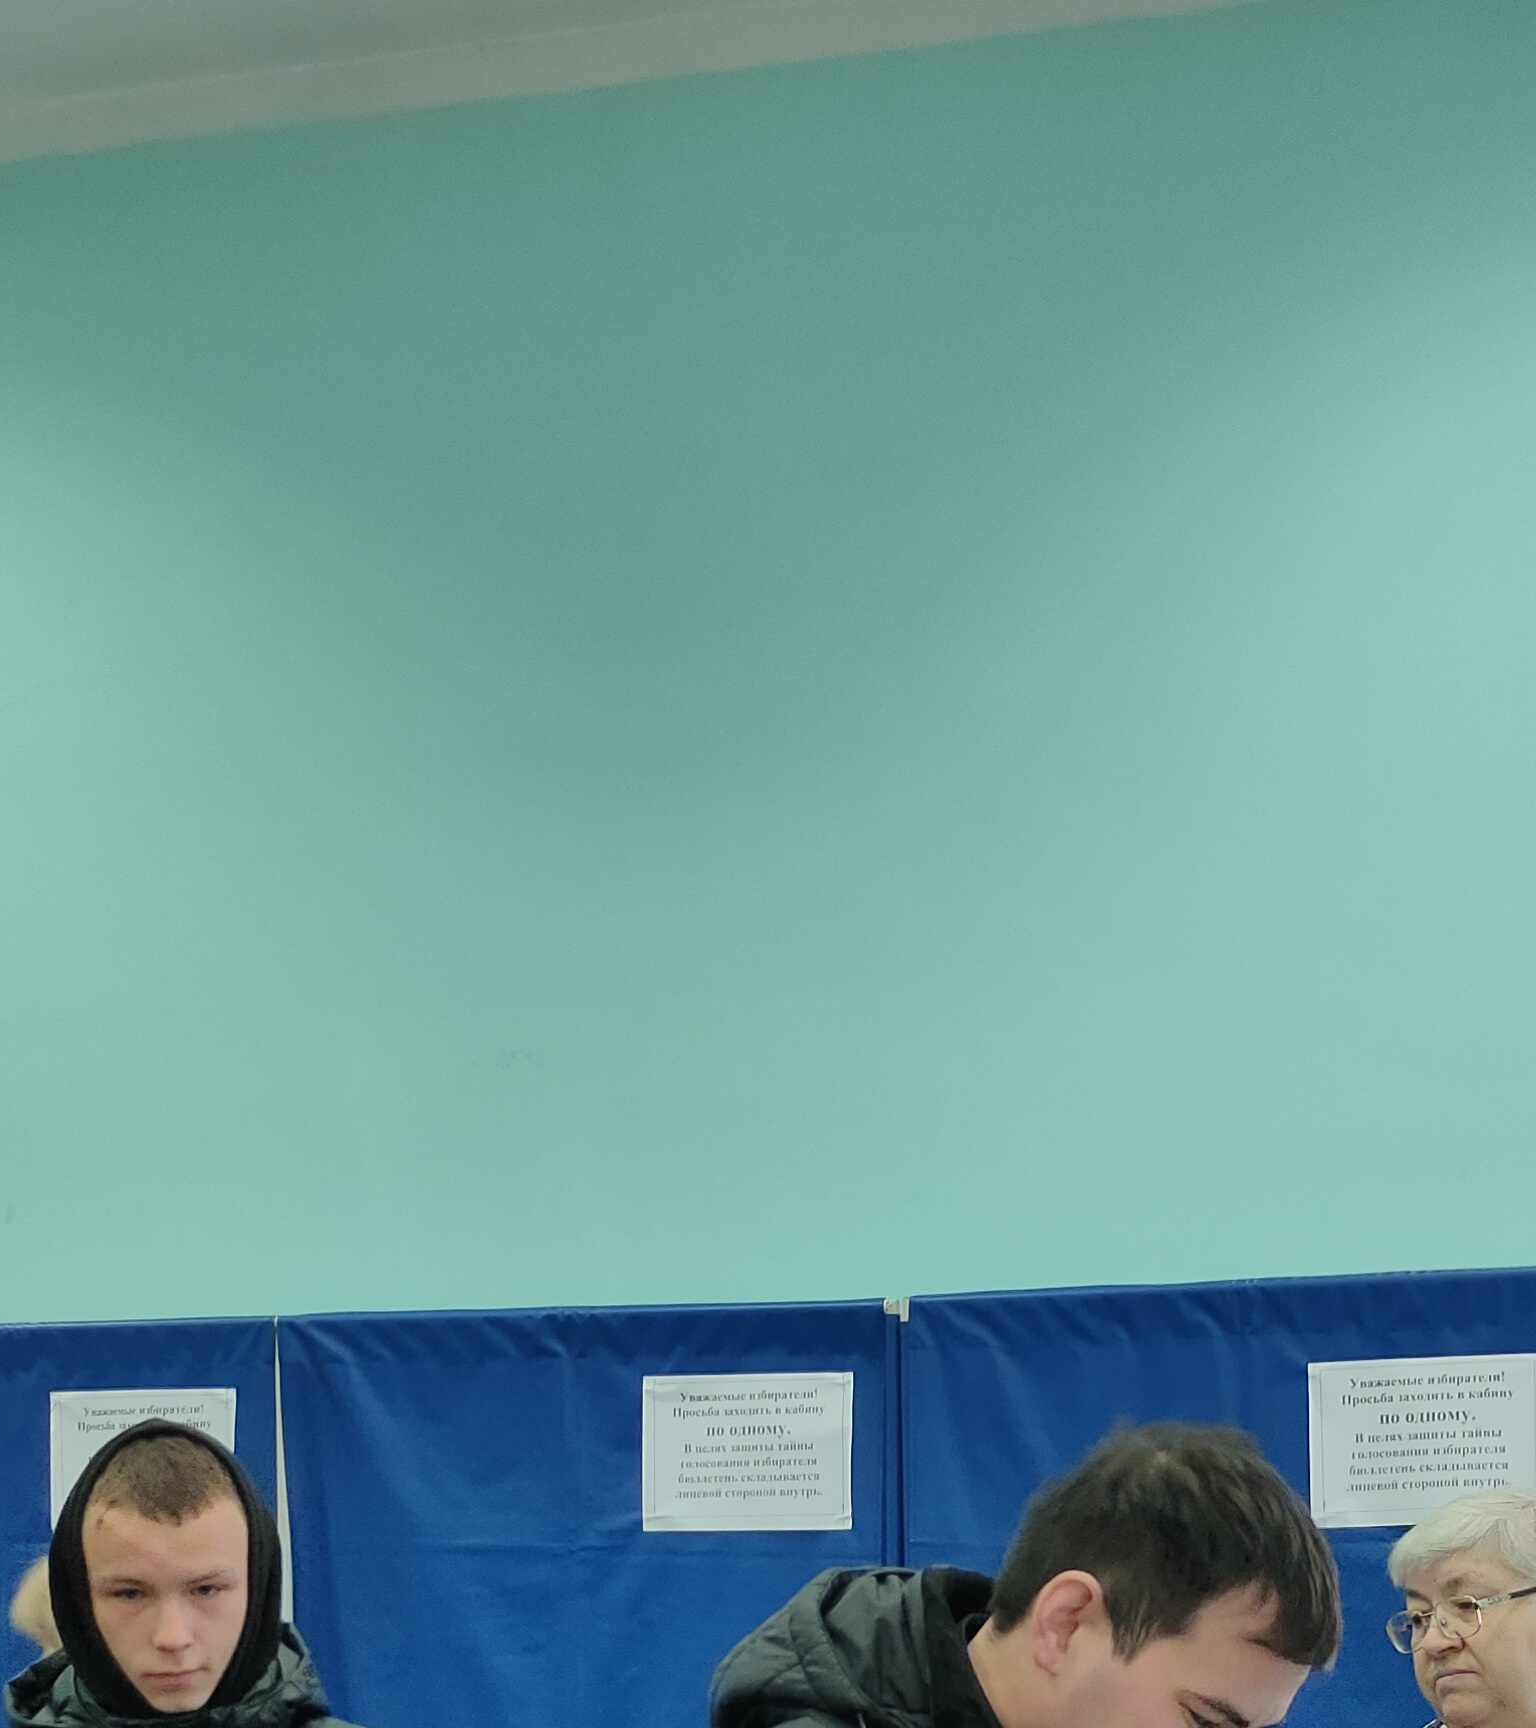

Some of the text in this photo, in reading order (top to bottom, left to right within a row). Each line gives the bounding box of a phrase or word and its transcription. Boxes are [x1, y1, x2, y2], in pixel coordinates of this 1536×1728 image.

[1349, 1371, 1506, 1389] Уважаемые избиратели!
[1341, 1392, 1394, 1407] Просьба
[1398, 1391, 1454, 1402] заходить
[1468, 1387, 1513, 1401] кабину
[1367, 1433, 1403, 1444] целях
[1408, 1430, 1457, 1441] защиты
[1461, 1427, 1502, 1438] тайны
[1351, 1443, 1506, 1460] голосования избирателя
[1349, 1461, 1509, 1476] бюллетень складывается
[1346, 1479, 1399, 1492] лицевой
[1401, 1477, 1459, 1491] стороной
